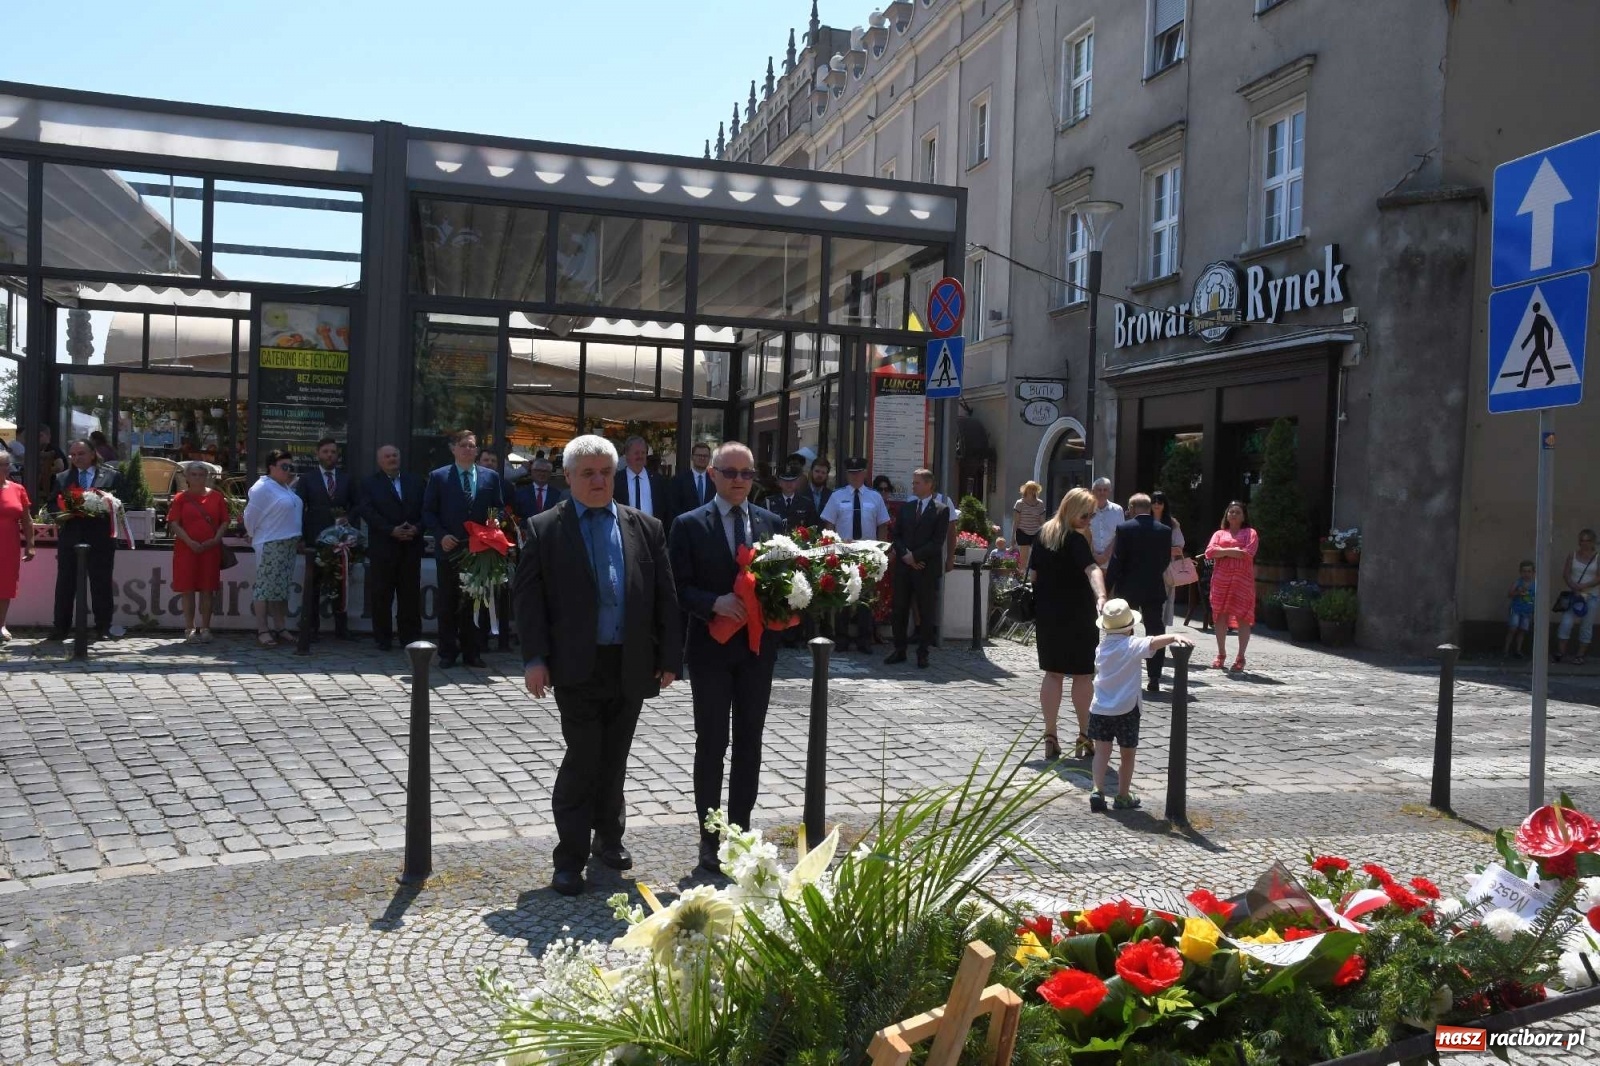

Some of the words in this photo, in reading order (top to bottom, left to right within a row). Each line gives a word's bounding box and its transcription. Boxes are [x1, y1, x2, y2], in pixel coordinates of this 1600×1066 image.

[1113, 301, 1190, 349] Browar
[1246, 244, 1344, 324] Rynek
[261, 350, 297, 367] CATERING
[298, 352, 348, 369] DIETETYCZNY
[297, 373, 310, 384] BEZ
[312, 374, 345, 385] PSZENICY
[883, 378, 921, 389] LUNCH
[1029, 384, 1055, 396] BUTIK
[1489, 879, 1530, 912] Nasze
